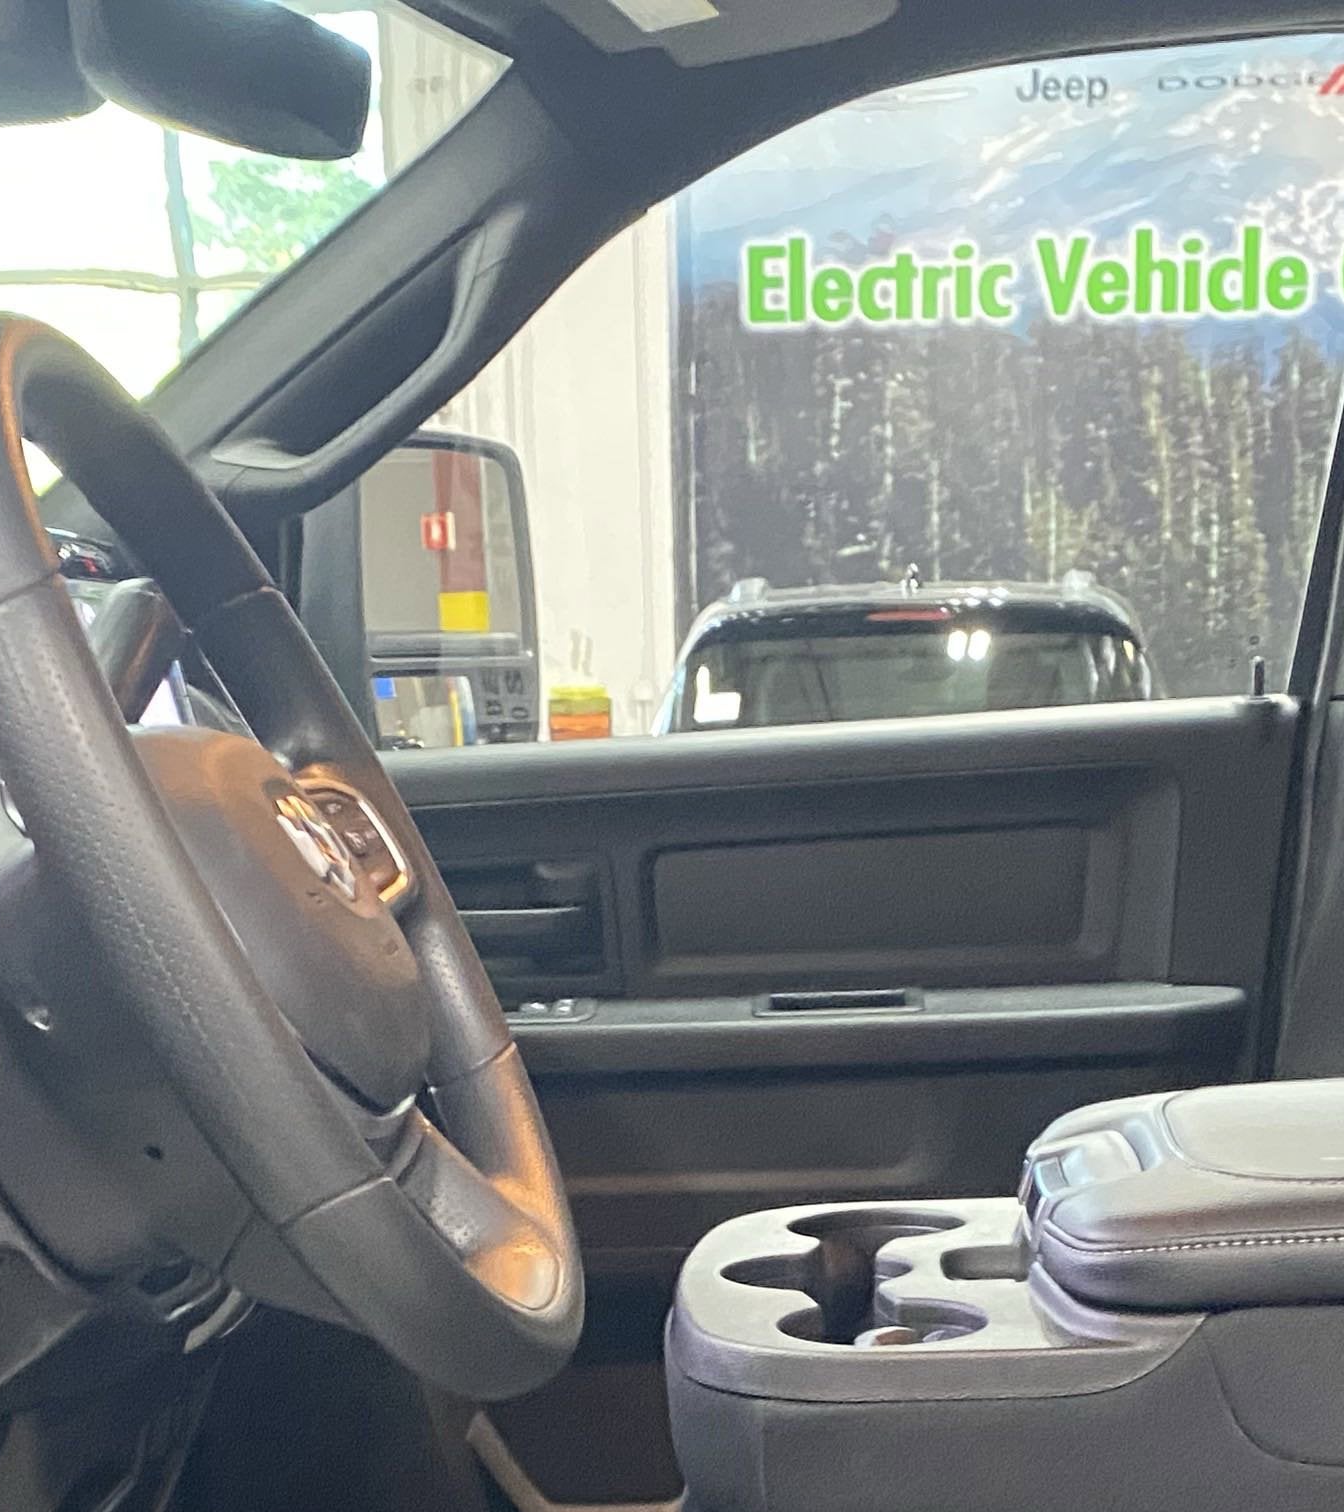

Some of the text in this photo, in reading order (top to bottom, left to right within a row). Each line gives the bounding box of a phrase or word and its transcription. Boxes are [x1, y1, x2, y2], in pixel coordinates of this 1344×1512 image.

[1016, 68, 1108, 106] Jeep
[746, 236, 1014, 323] Electric
[1037, 228, 1310, 316] Vehicle
